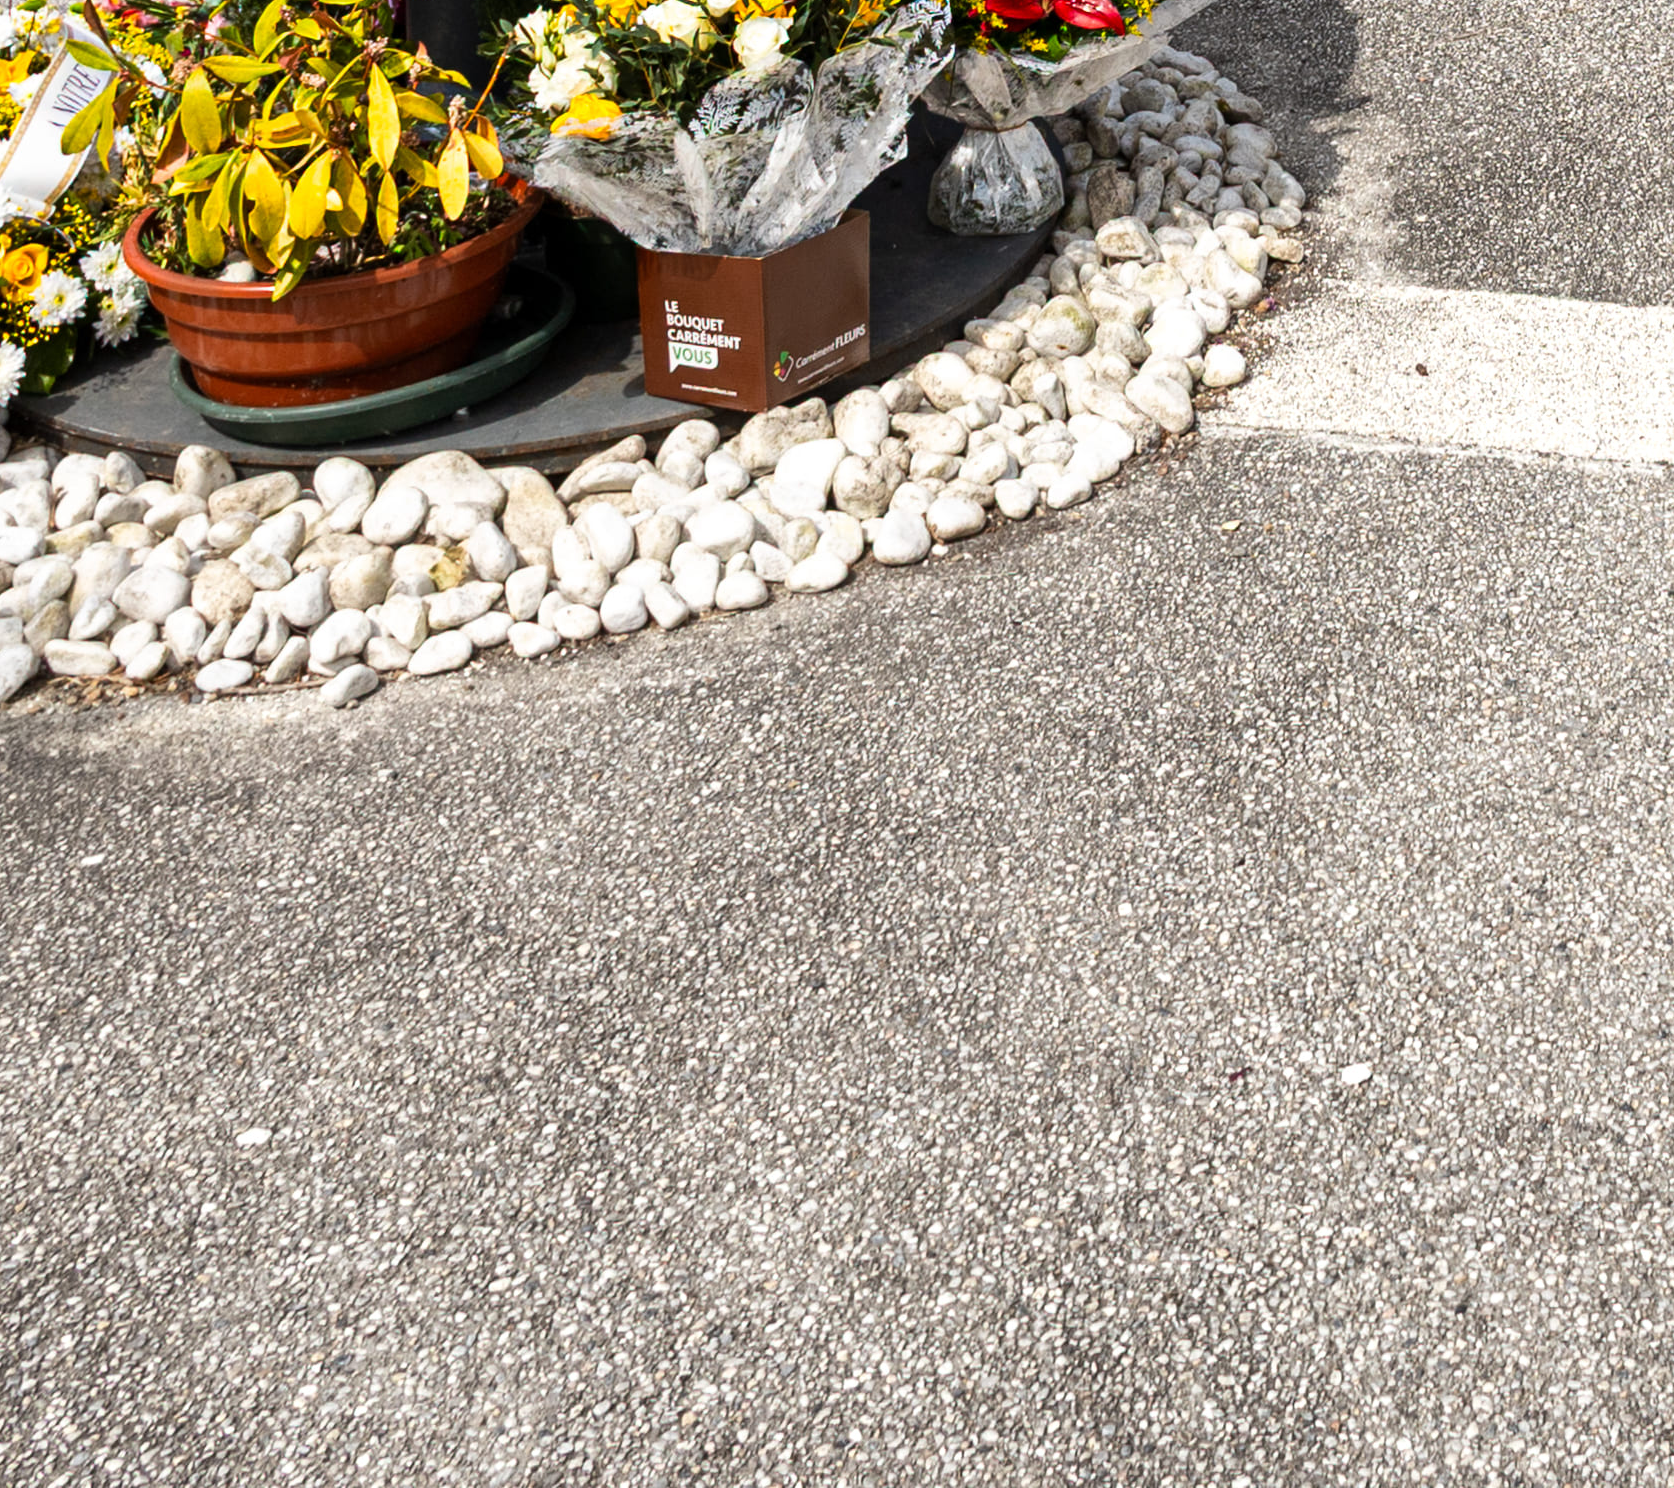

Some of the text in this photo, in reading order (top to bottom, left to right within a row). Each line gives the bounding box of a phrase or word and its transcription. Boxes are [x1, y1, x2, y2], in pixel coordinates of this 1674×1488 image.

[664, 299, 679, 313] LE
[666, 313, 724, 333] BOUQUET
[667, 328, 742, 350] CARRÉMENT
[835, 323, 866, 349] FLEURS
[672, 345, 712, 365] VOUS
